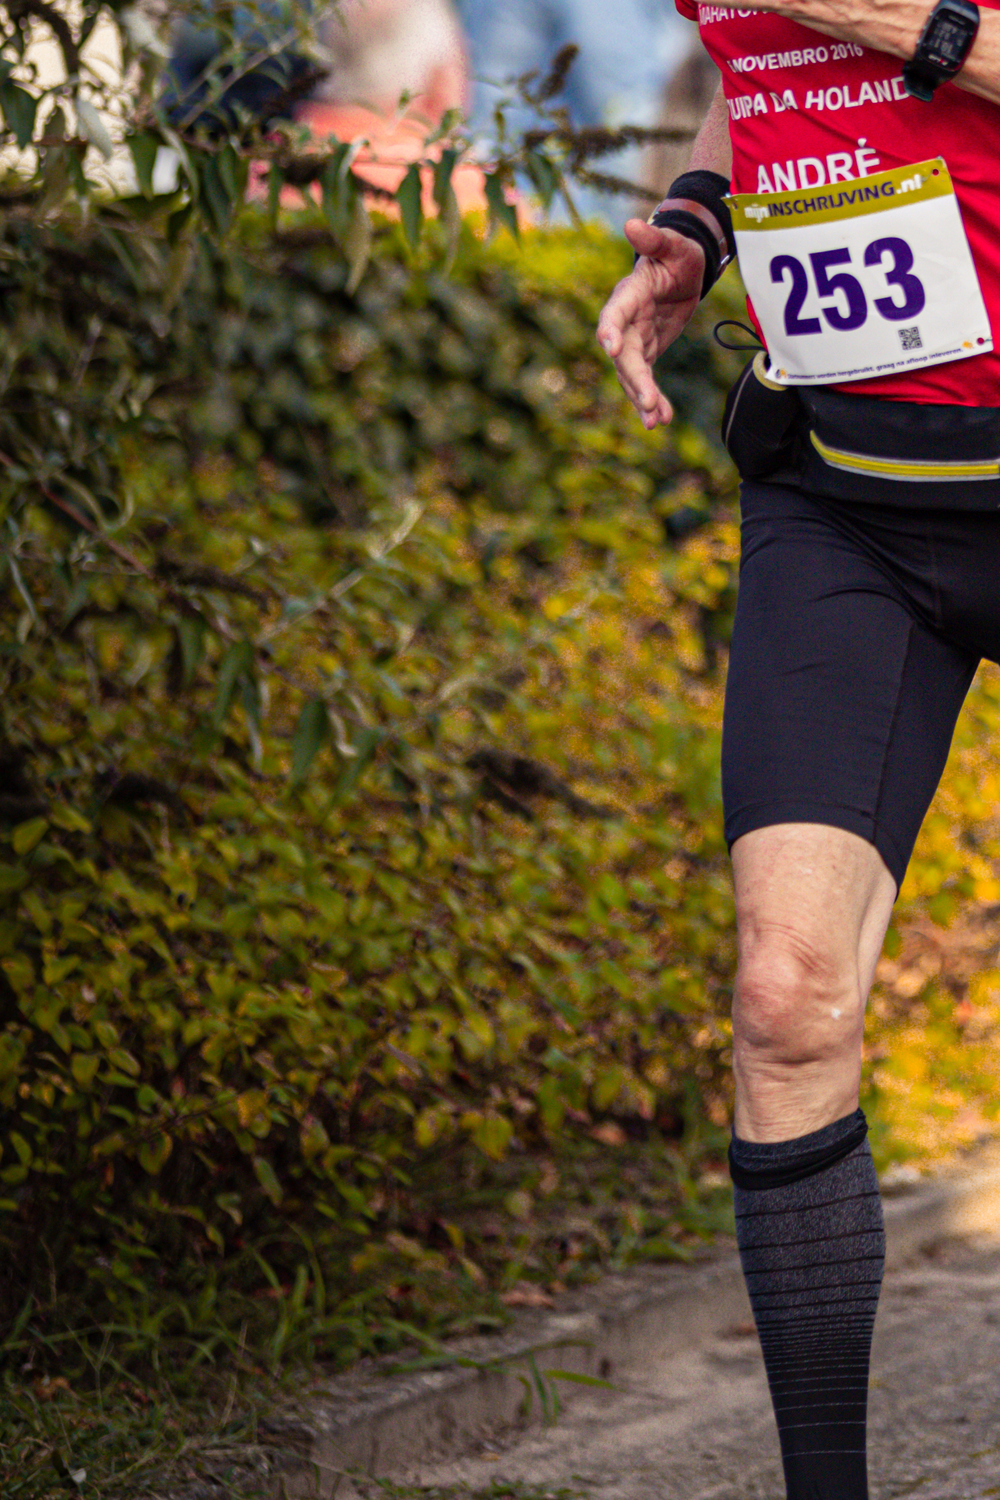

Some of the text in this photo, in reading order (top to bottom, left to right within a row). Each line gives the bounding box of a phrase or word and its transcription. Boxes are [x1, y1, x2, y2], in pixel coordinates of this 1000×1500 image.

[830, 43, 863, 60] 2016
[769, 89, 798, 112] DA
[757, 138, 880, 194] ANDRÉ
[769, 236, 926, 337] 253
[876, 362, 895, 372] graag
[906, 356, 928, 365] afloop
